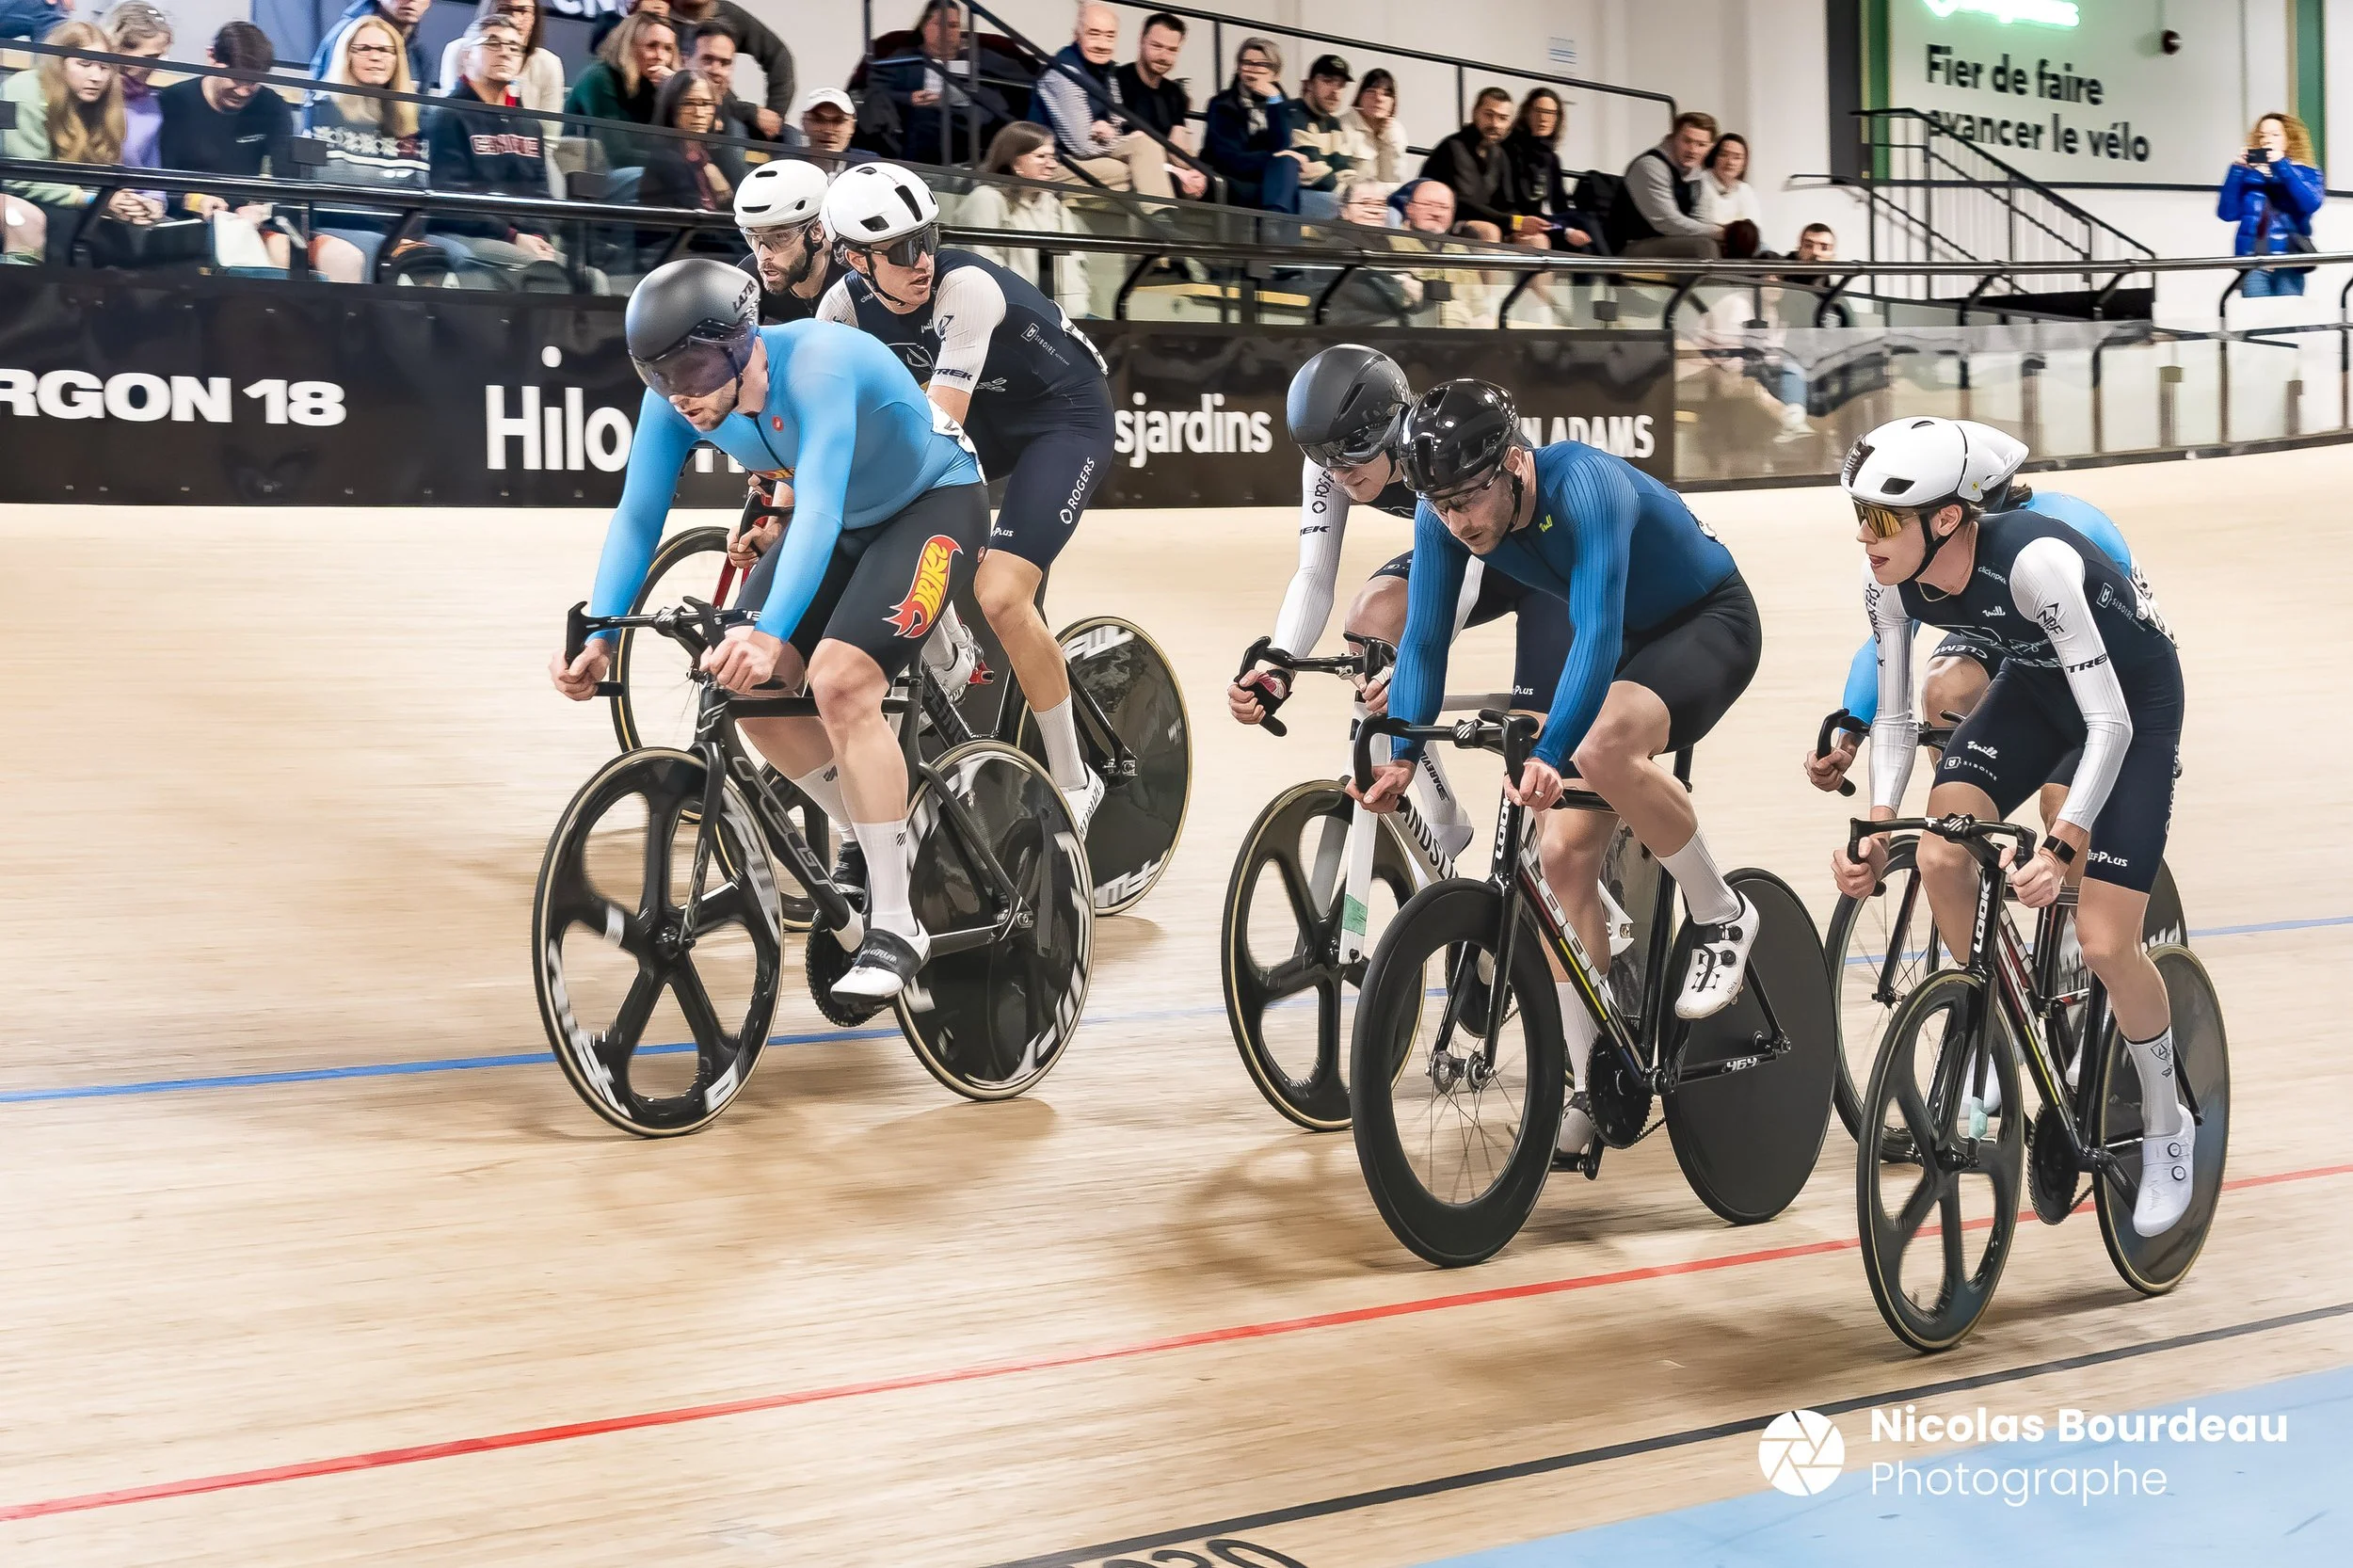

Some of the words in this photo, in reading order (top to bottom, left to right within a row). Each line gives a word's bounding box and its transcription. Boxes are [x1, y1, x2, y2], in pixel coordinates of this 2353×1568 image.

[1926, 43, 1983, 88] Fier
[1992, 53, 2028, 95] de
[2037, 58, 2104, 105] faire
[1929, 109, 2043, 151] avancer
[2051, 113, 2078, 154] le
[2086, 121, 2150, 162] vélo
[1035, 335, 1056, 356] SIBOIRE
[0, 368, 232, 424] RGON
[242, 378, 347, 426] 18
[1114, 392, 1273, 468] sjardins
[1549, 414, 1656, 458] ADAMS
[1067, 456, 1095, 510] ROGERS
[1315, 470, 1335, 498] ROGE
[1300, 525, 1330, 536] EK
[2111, 598, 2134, 620] SIBOIRE
[1934, 644, 1988, 659] CLEM
[2067, 652, 2108, 673] TRE
[1974, 879, 1992, 953] LOOK
